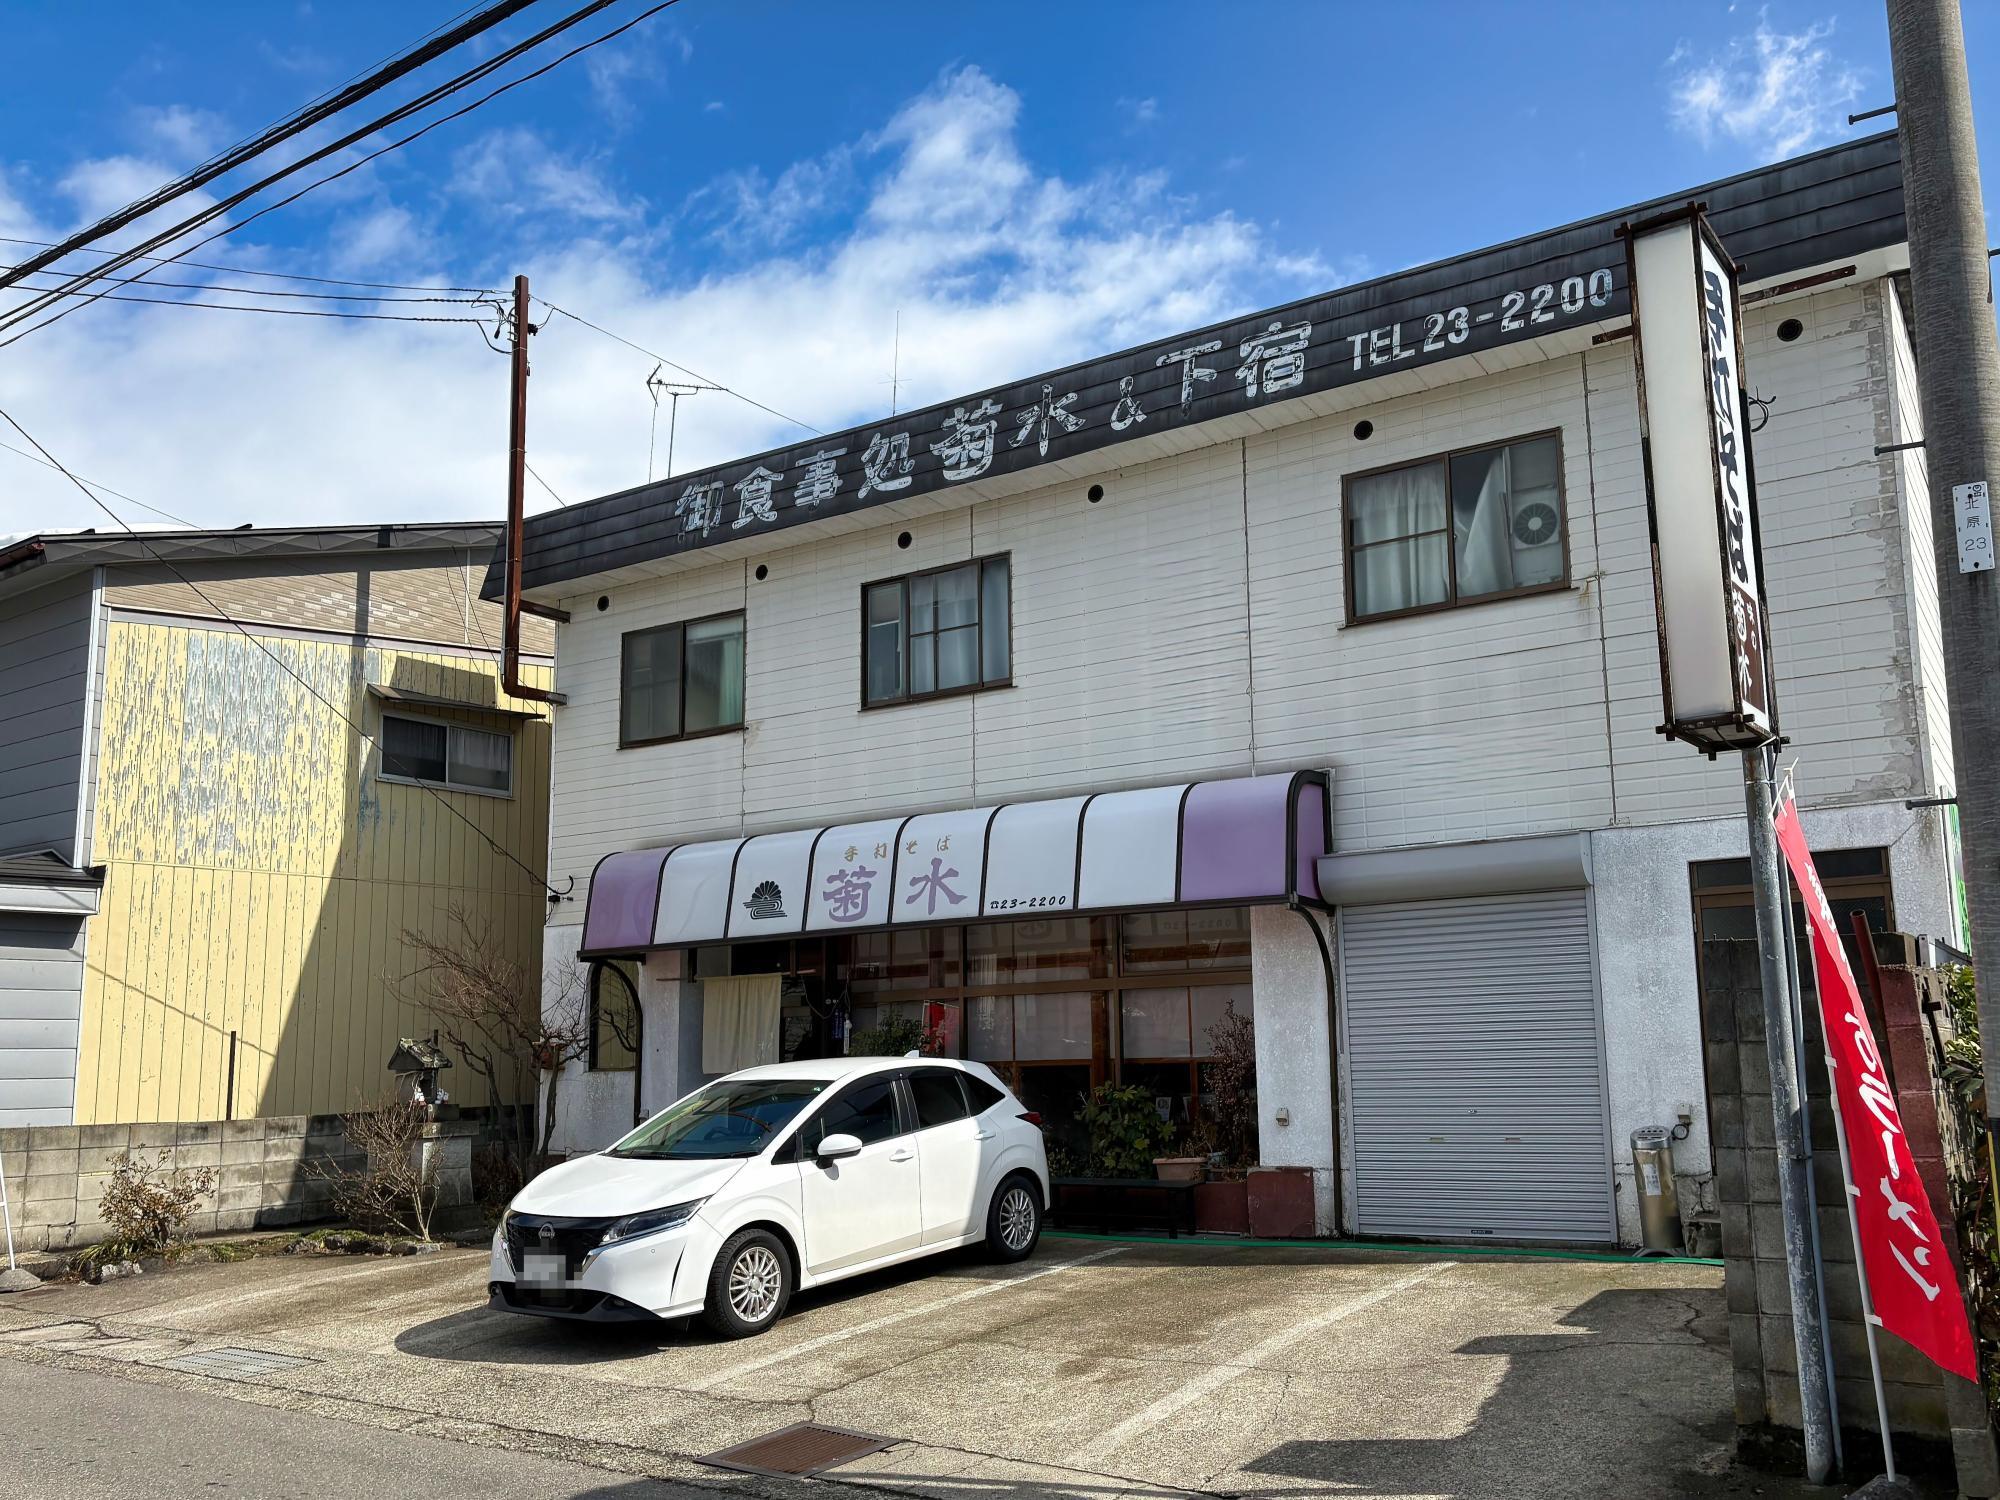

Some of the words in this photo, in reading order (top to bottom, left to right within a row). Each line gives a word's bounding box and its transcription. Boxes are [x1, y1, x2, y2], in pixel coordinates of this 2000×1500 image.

[1346, 322, 1416, 372] TEL
[1423, 268, 1614, 353] 23-2200
[1964, 536, 1987, 552] 23
[1732, 588, 1753, 701] 菊水
[844, 834, 952, 862] 手打そば
[822, 857, 968, 922] 菊水
[1000, 895, 1067, 910] 23-2200
